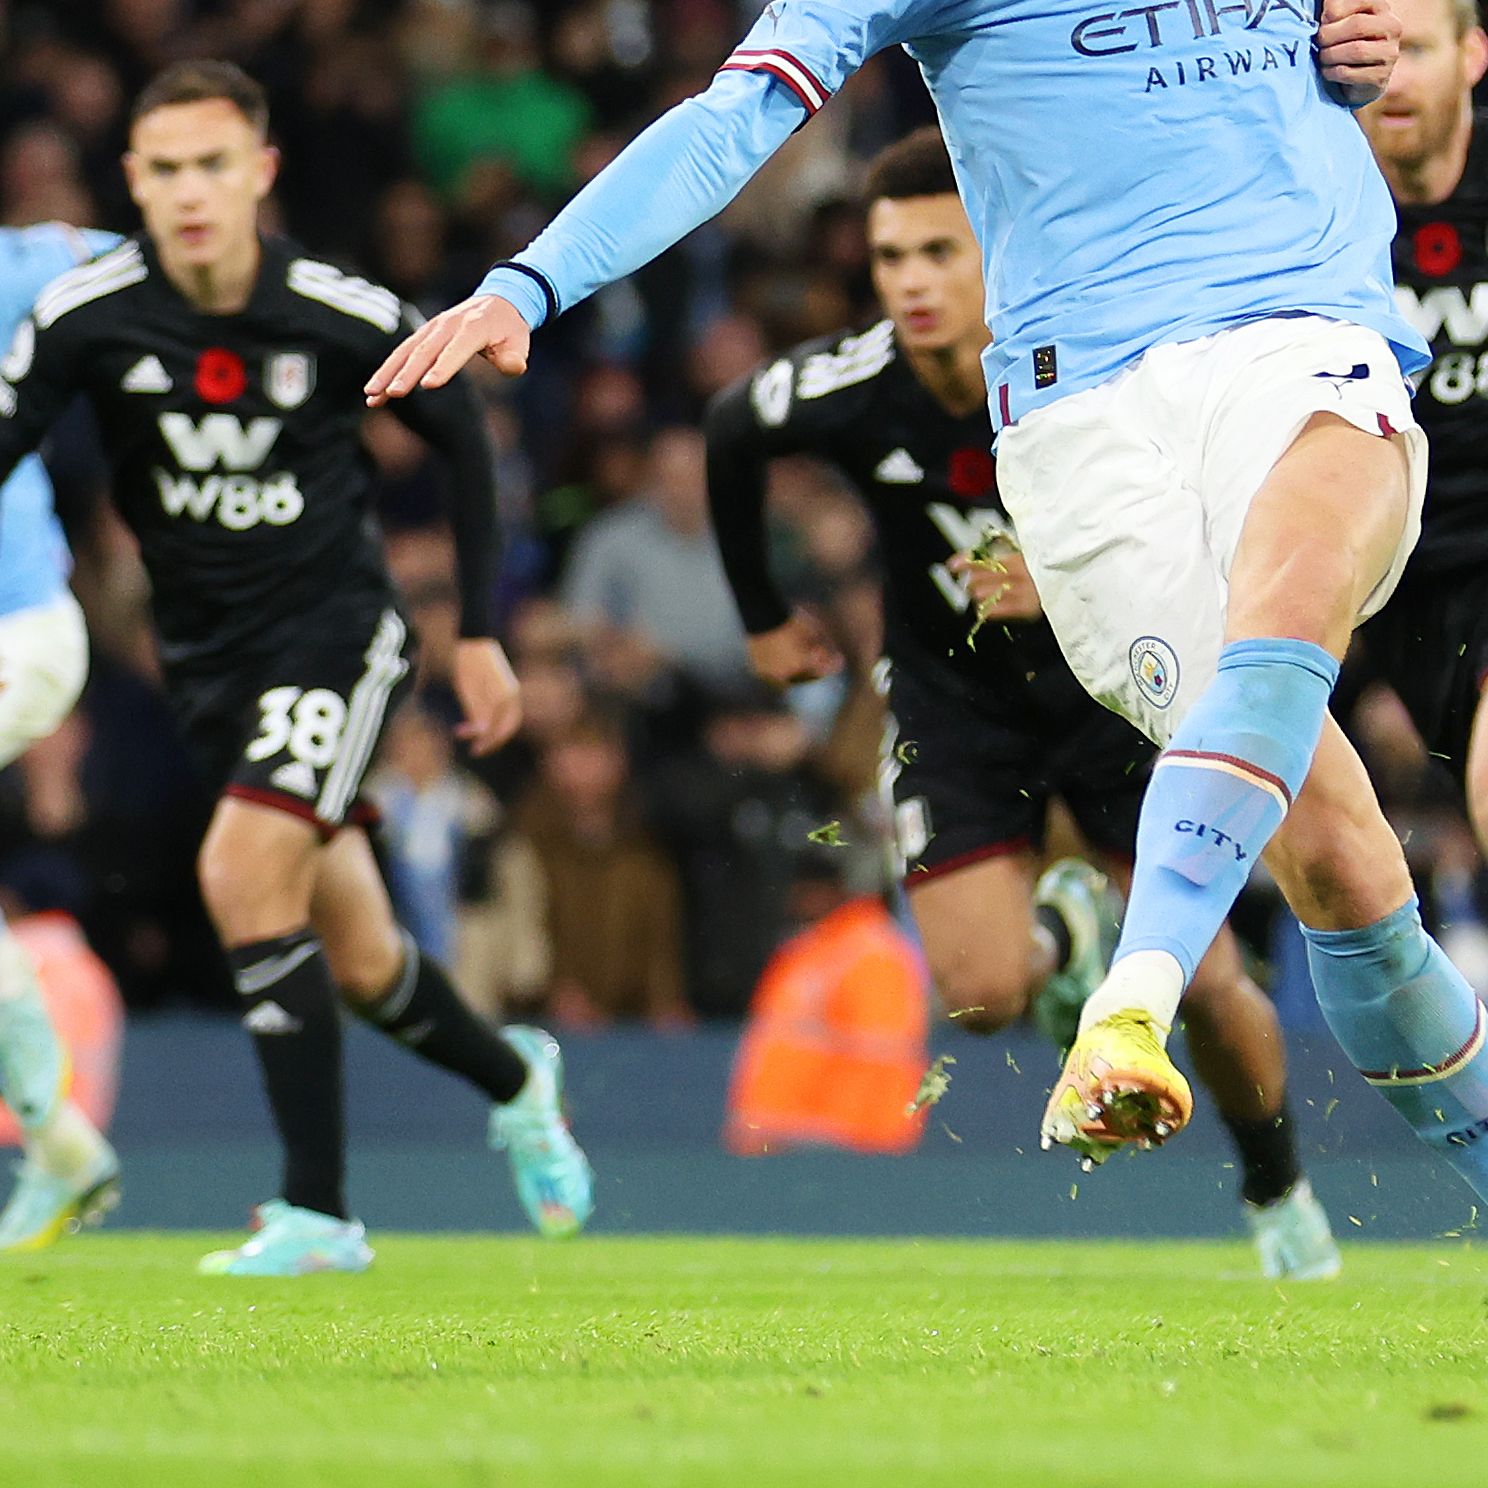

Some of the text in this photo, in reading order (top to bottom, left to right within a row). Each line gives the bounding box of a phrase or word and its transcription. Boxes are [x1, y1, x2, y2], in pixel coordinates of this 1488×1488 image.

[1145, 40, 1300, 93] AIRWAY
[245, 685, 349, 769] 38
[1174, 819, 1247, 861] CITY
